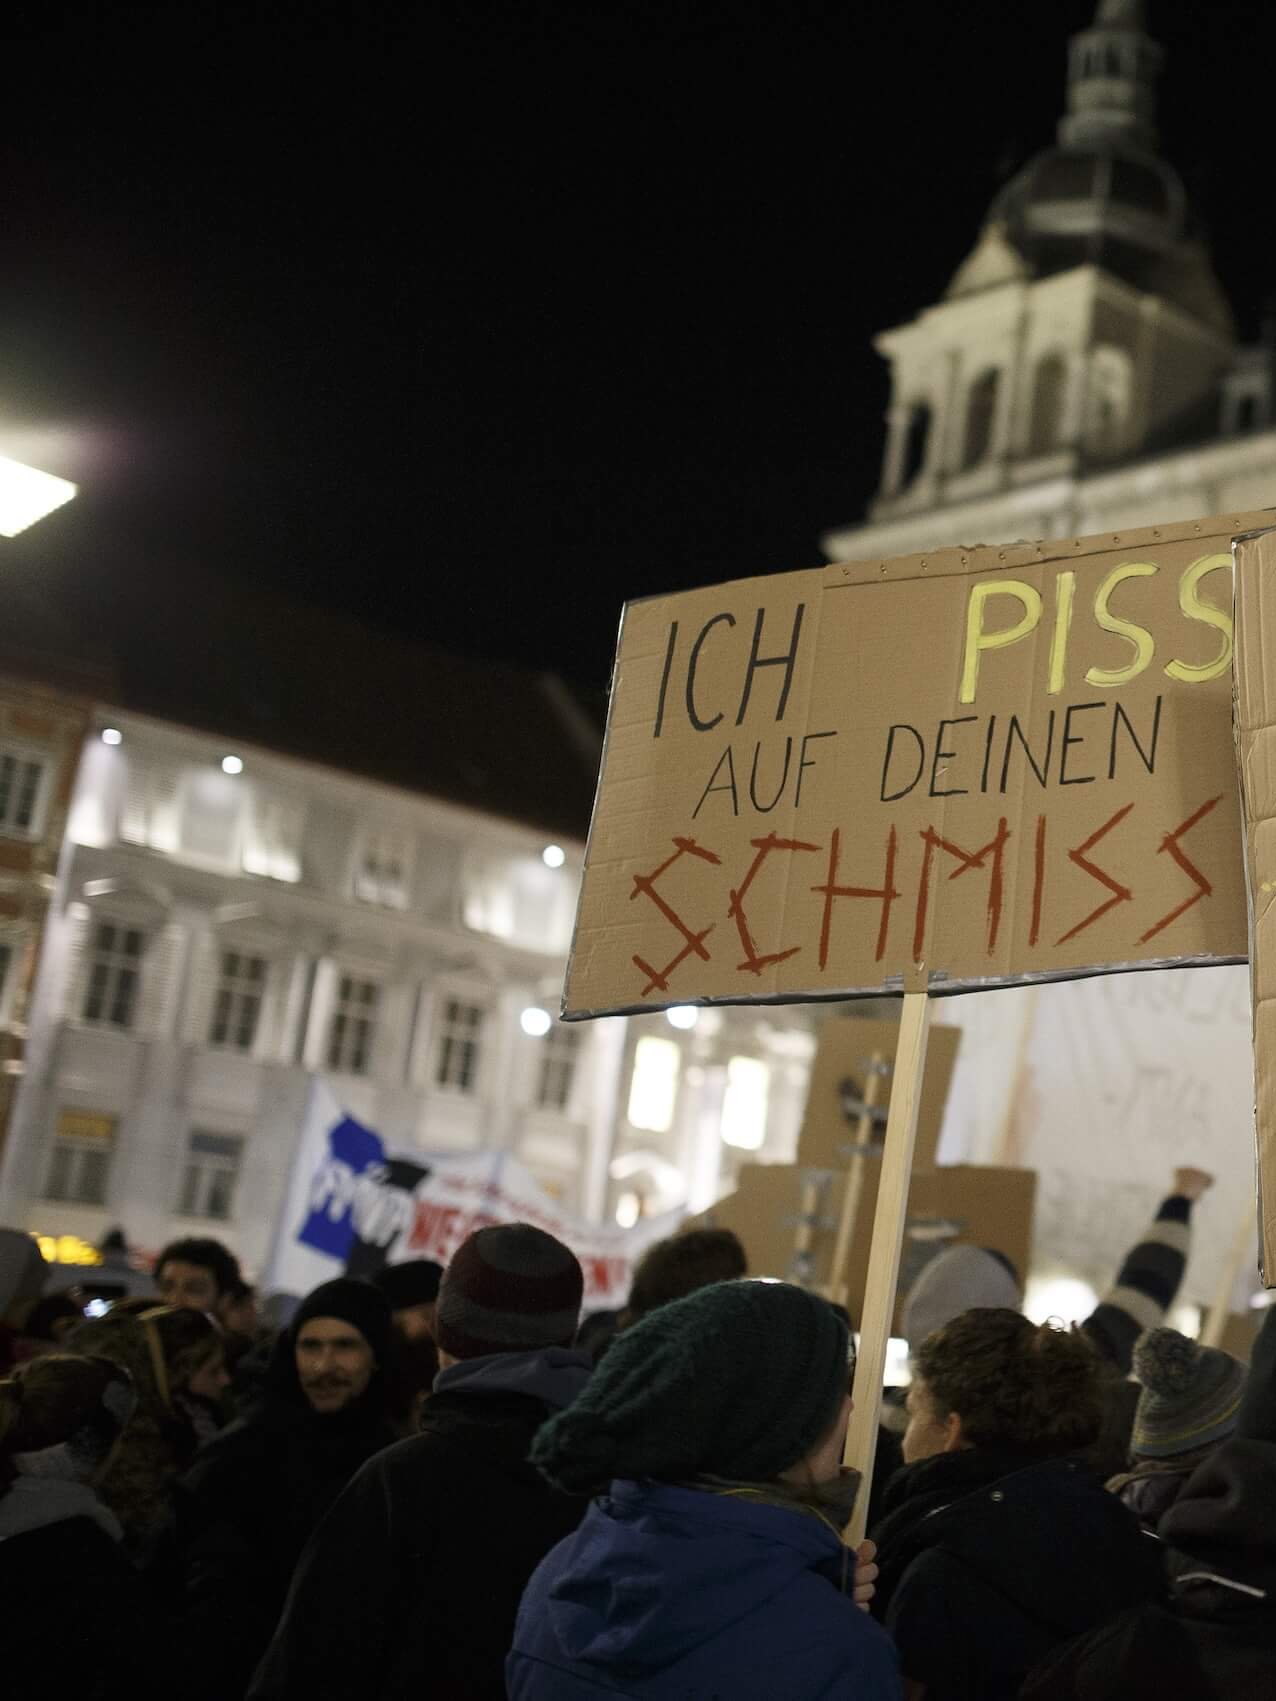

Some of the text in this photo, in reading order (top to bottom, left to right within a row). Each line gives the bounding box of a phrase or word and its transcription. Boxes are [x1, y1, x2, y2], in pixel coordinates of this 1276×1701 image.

[652, 552, 1233, 738] ICH PISS
[692, 695, 1163, 820] AUF DEINEN
[630, 795, 1225, 997] SCHMISS
